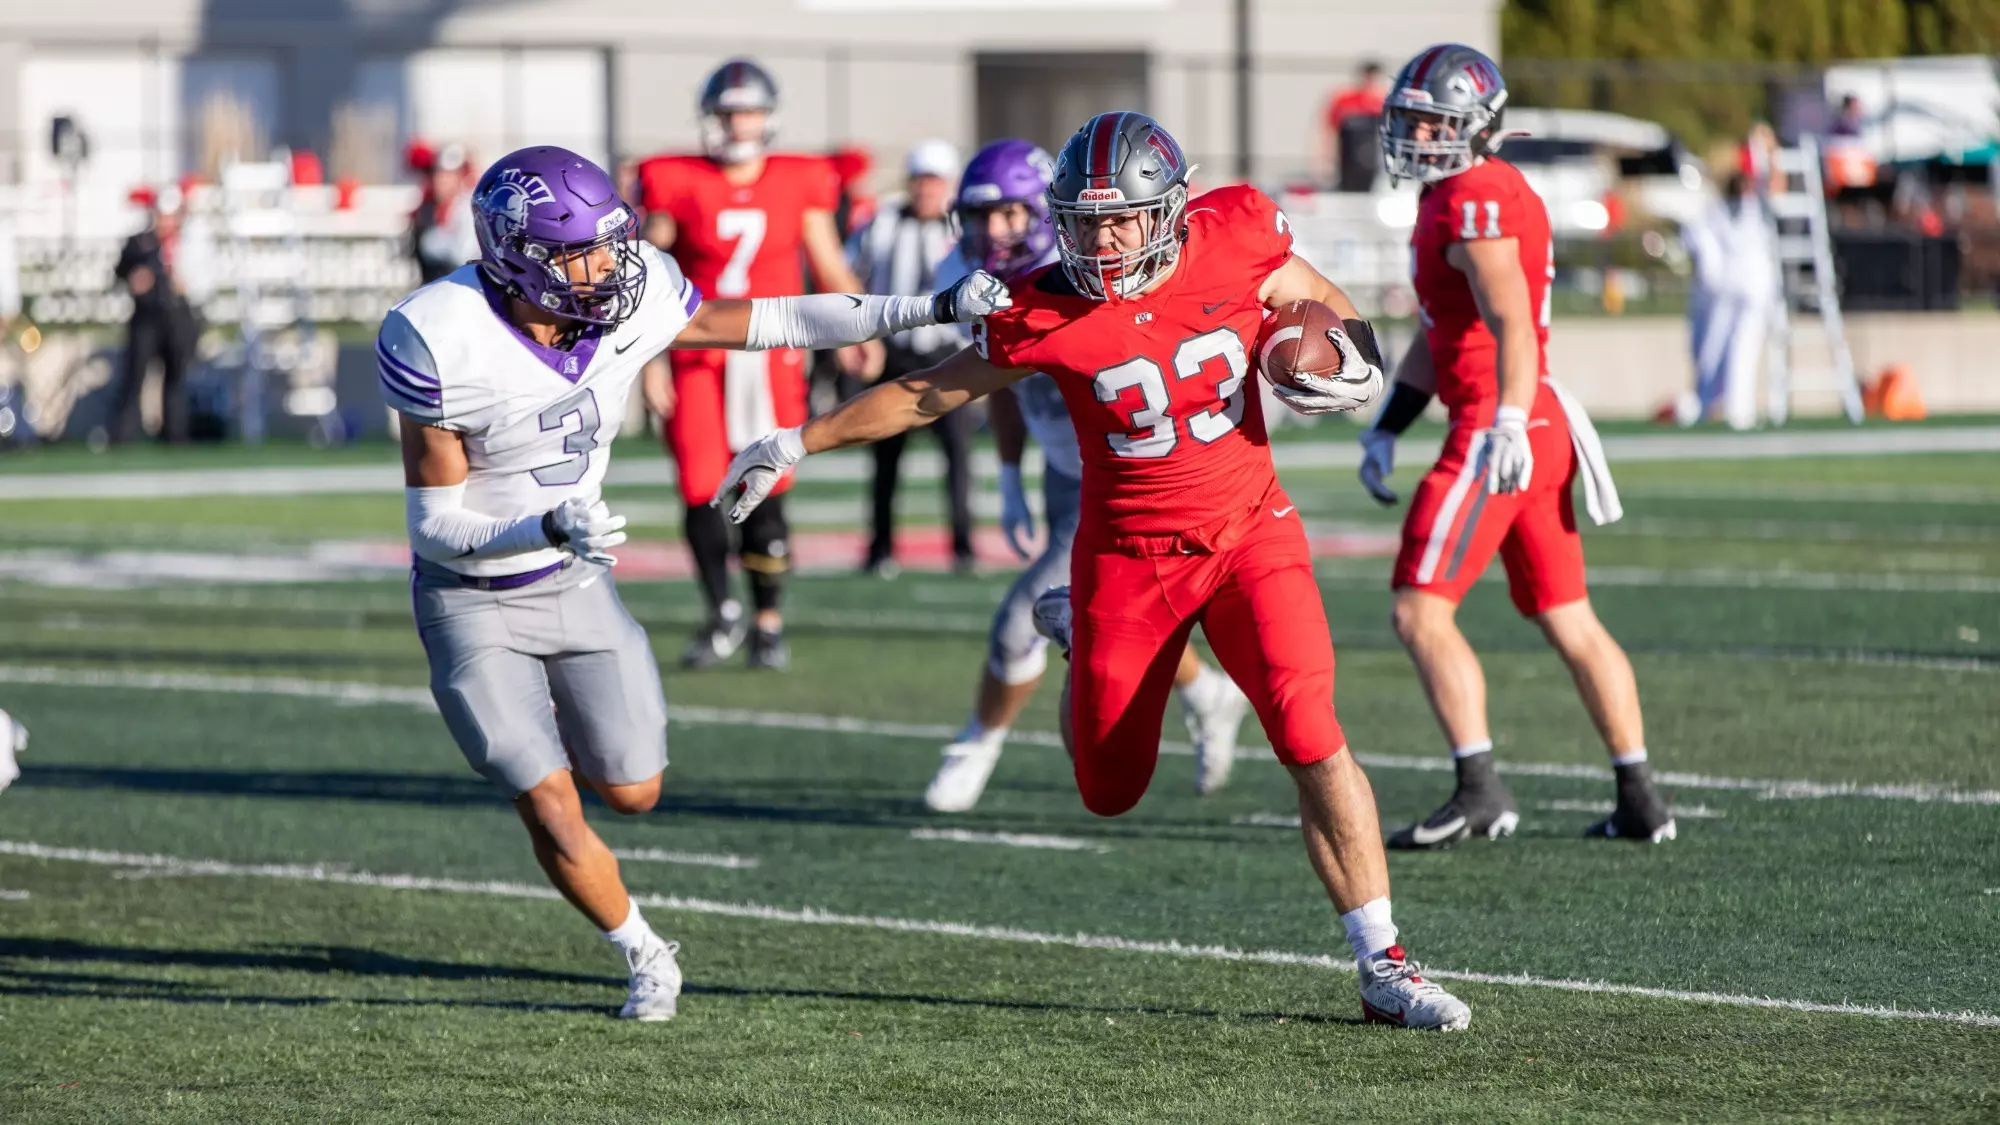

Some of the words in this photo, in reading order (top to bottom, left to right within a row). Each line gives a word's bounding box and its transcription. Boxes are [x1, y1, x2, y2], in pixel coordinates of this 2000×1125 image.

[1081, 191, 1118, 201] Riddell
[1460, 200, 1502, 239] 11
[716, 208, 768, 297] 7
[1092, 324, 1249, 459] 33
[530, 387, 601, 486] 3
